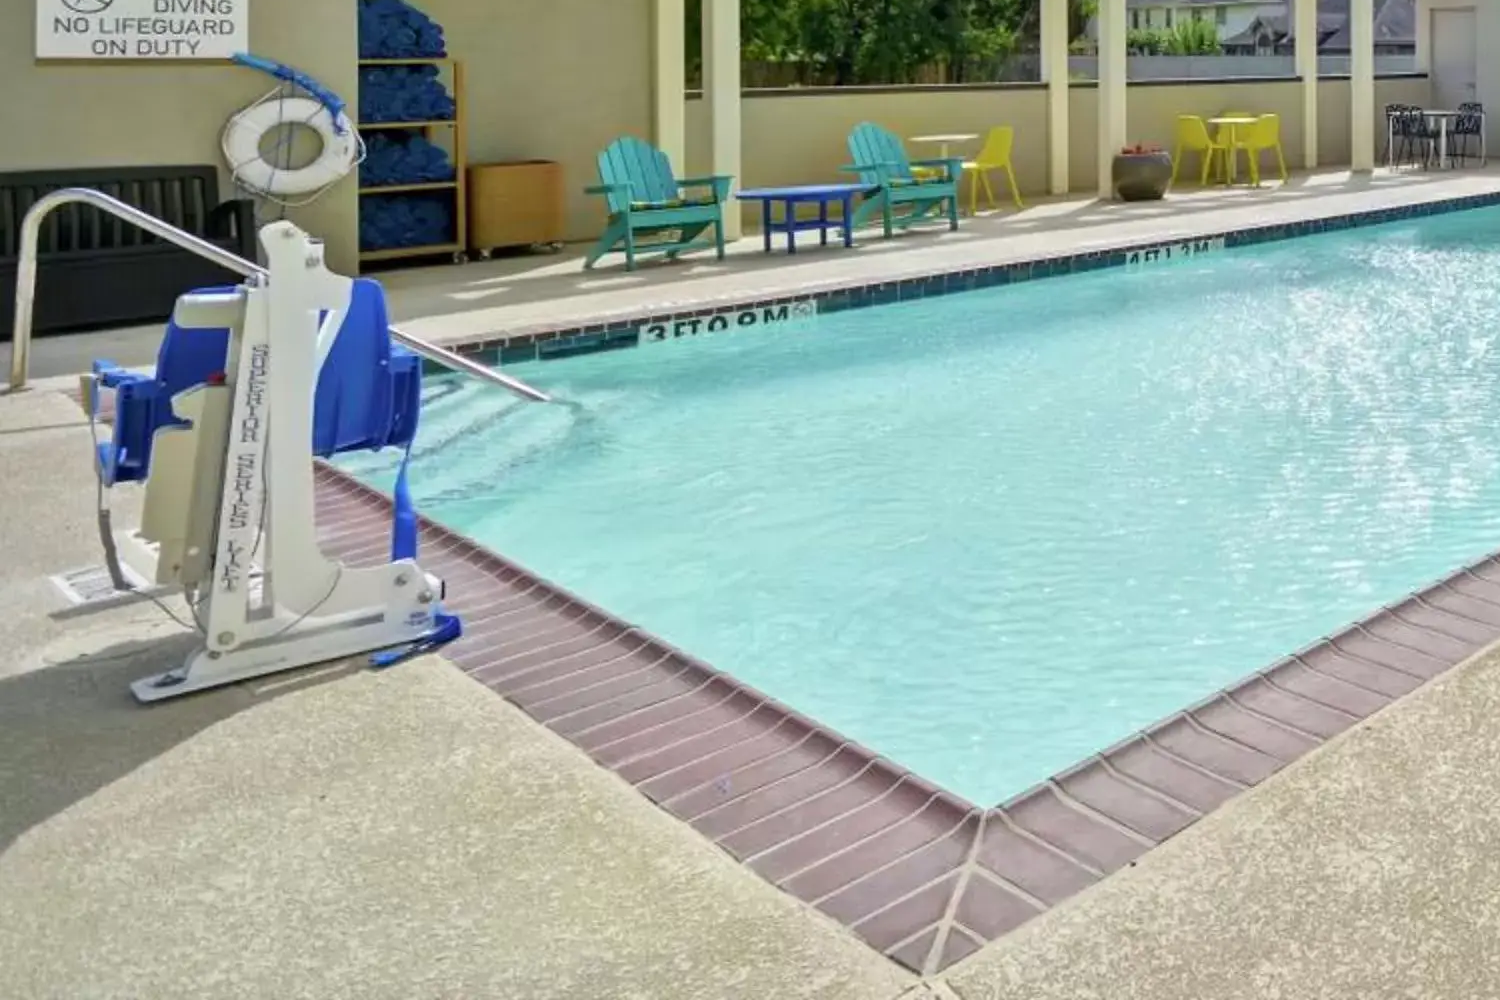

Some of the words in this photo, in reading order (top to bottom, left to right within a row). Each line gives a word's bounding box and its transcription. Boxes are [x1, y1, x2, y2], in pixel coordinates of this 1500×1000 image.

[53, 16, 90, 34] NO
[99, 17, 235, 36] LIFEGUARD
[91, 39, 127, 56] ON
[136, 39, 201, 56] DUTY
